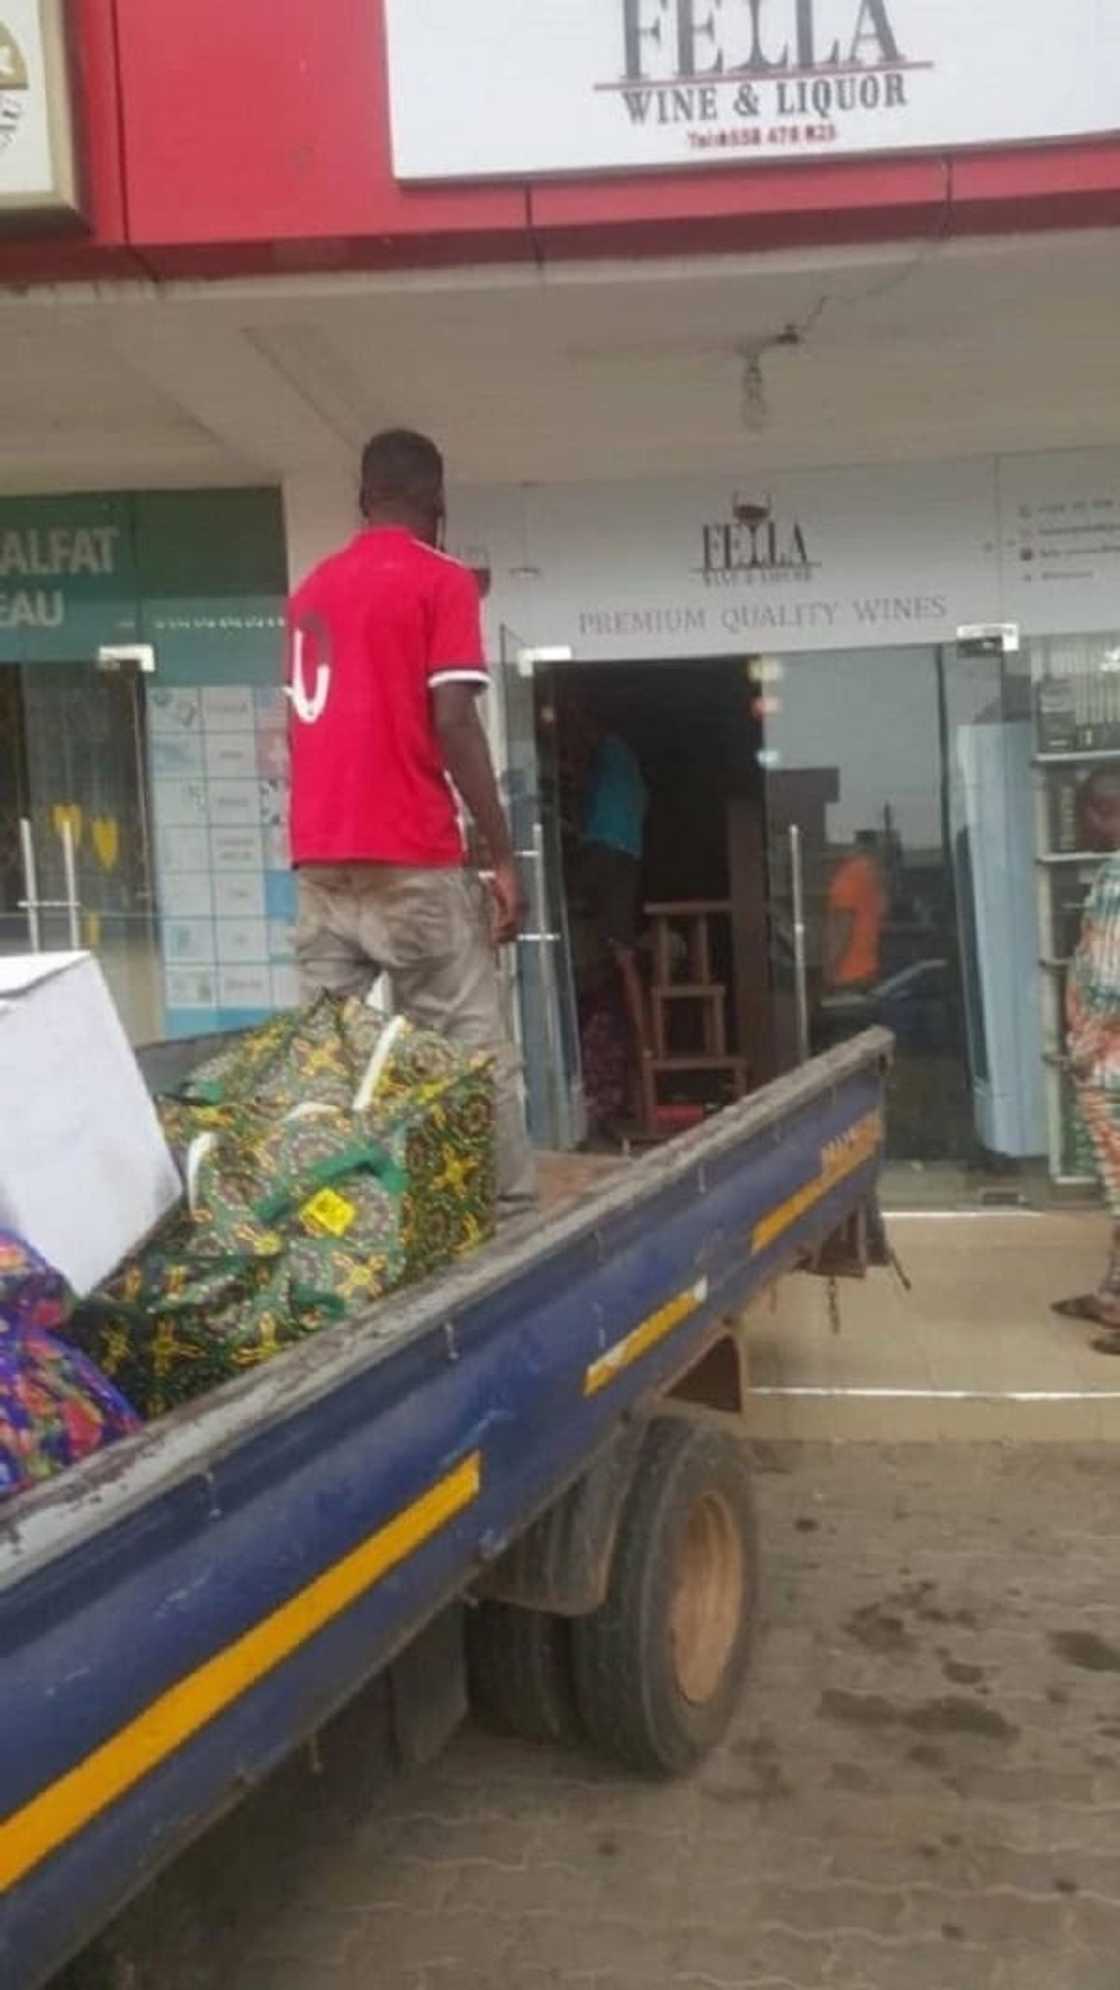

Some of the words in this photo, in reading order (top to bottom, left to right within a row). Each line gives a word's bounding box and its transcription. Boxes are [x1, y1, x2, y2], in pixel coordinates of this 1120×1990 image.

[621, 85, 718, 125] WINE
[732, 83, 760, 117] &
[776, 72, 908, 118] LIQUOR
[579, 608, 706, 637] PREMIUM
[721, 600, 839, 634] QUALITY
[853, 594, 950, 624] WINES
